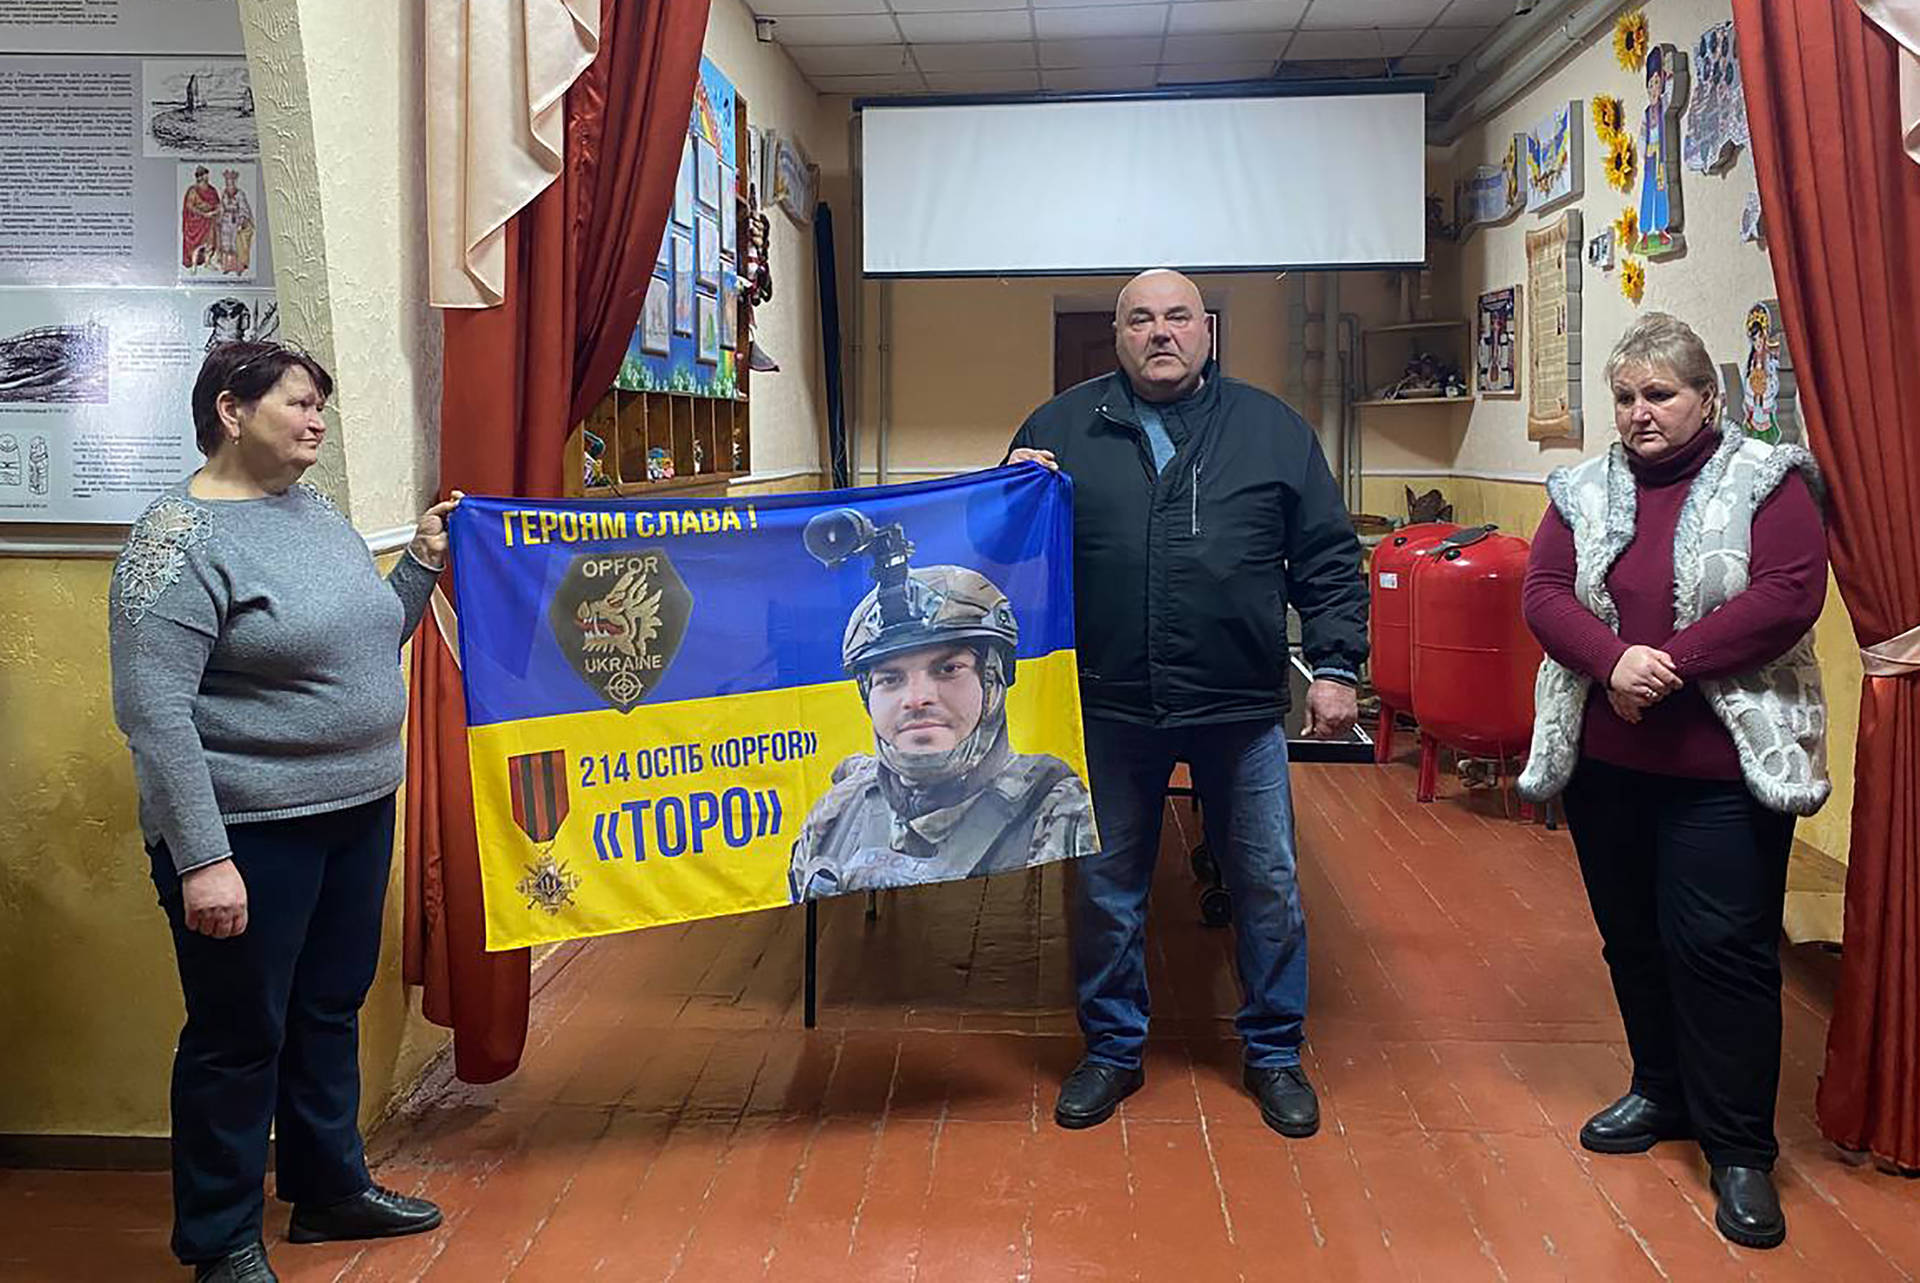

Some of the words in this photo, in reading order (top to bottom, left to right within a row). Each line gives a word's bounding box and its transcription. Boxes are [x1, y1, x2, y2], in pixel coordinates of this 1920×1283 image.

[503, 510, 627, 547] ГЕРОЯМ
[635, 508, 742, 538] СЛАВА
[582, 556, 659, 578] OPFOR
[584, 654, 663, 674] UKRAINE
[580, 751, 631, 787] 214
[636, 743, 704, 779] ОСПБ
[710, 730, 817, 768] «OPFOR»
[592, 786, 783, 862] «ТОРО»
